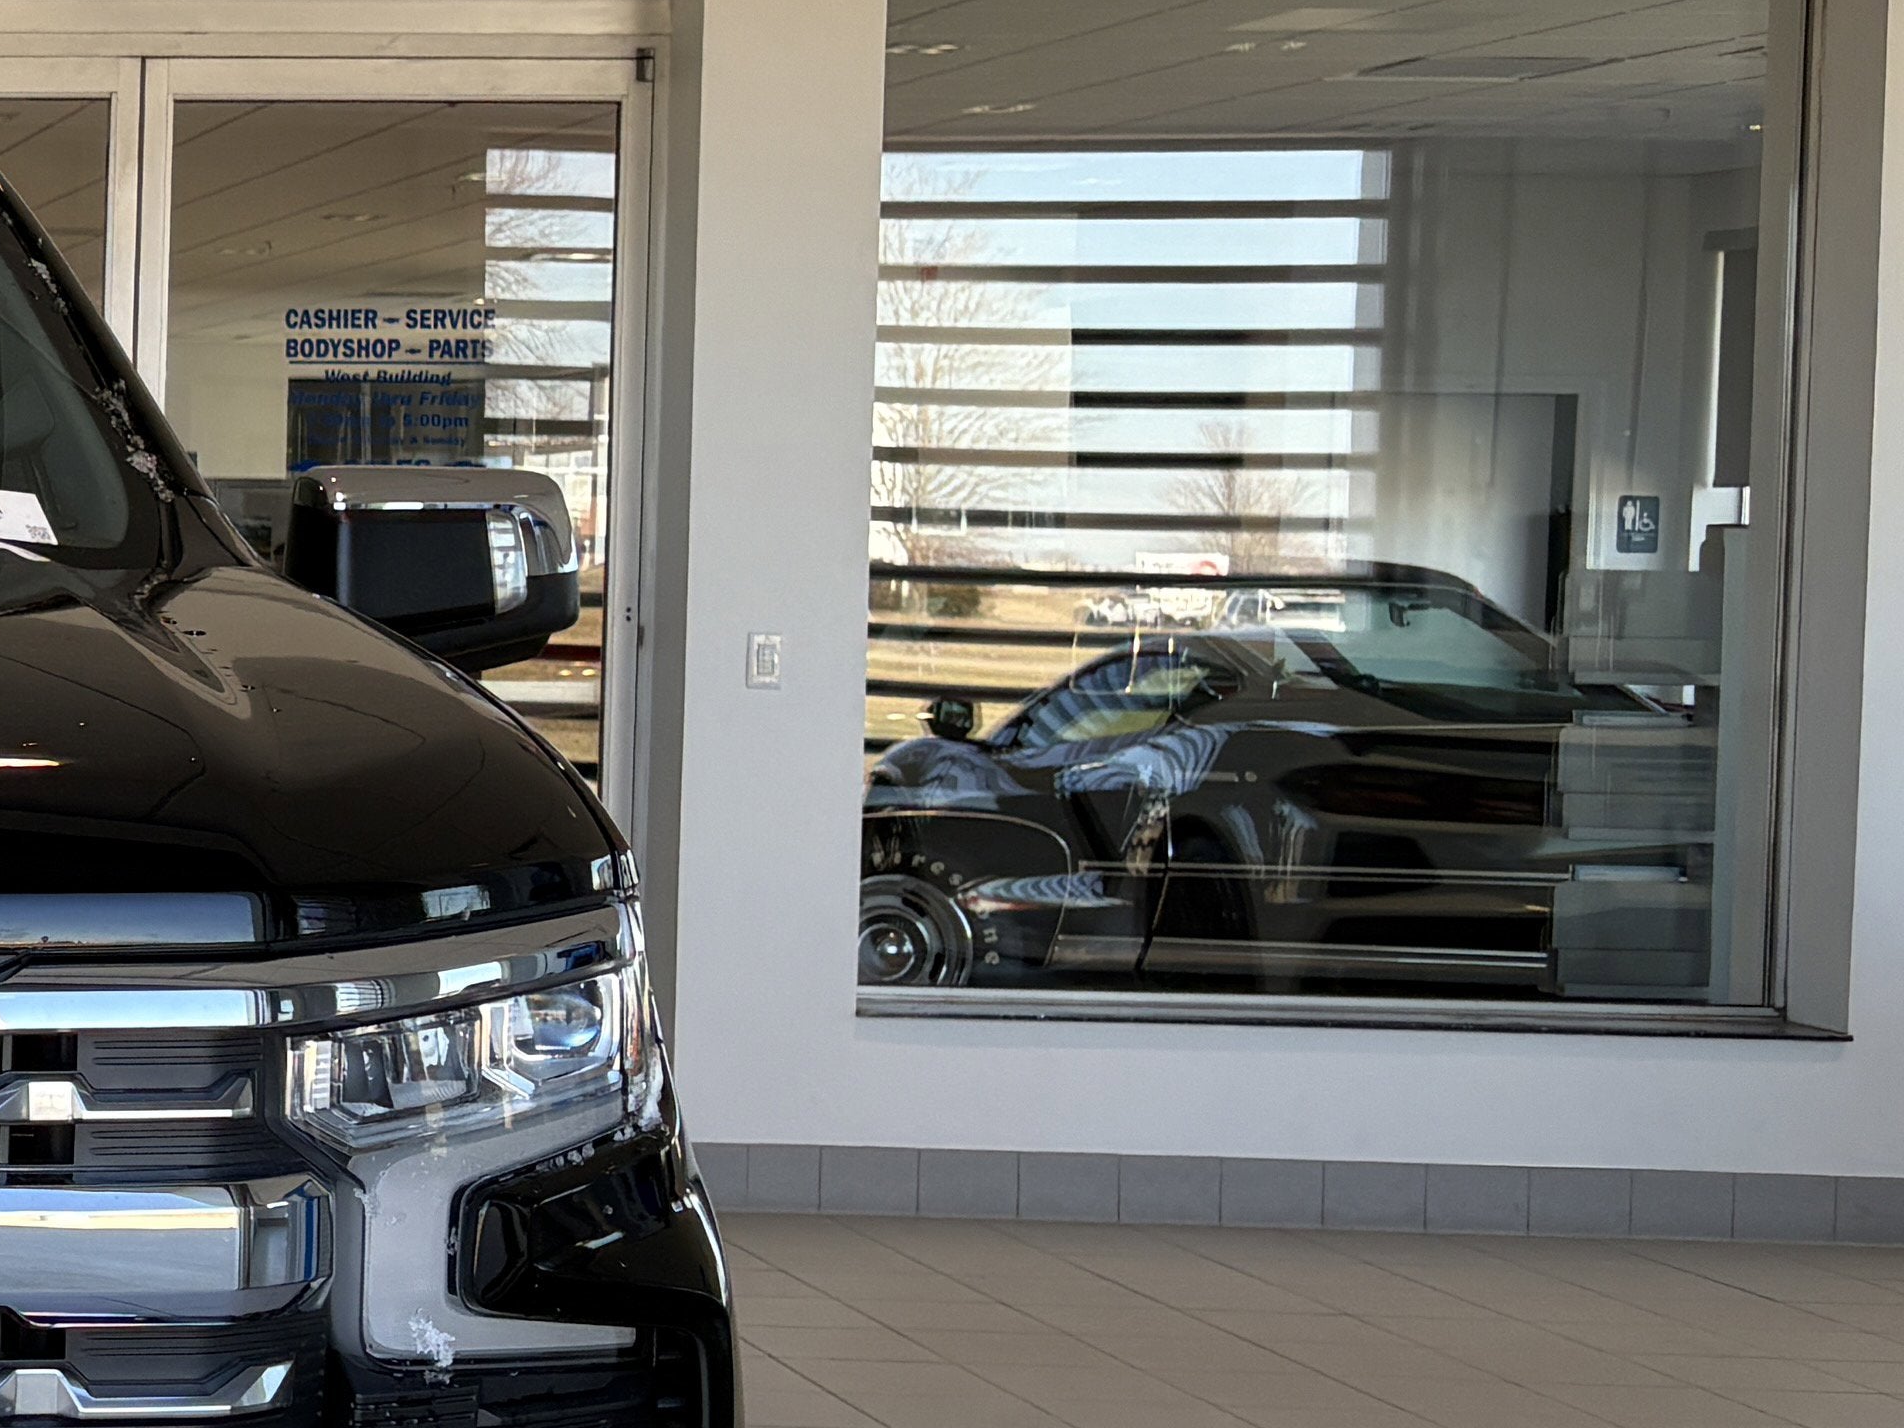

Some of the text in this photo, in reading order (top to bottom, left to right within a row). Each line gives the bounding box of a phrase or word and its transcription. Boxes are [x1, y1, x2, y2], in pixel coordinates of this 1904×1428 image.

[285, 308, 496, 329] CASHIER SERVICE
[285, 338, 494, 359] BODYSHOP PARTS
[324, 369, 452, 386] West Building
[419, 391, 481, 409] Friday
